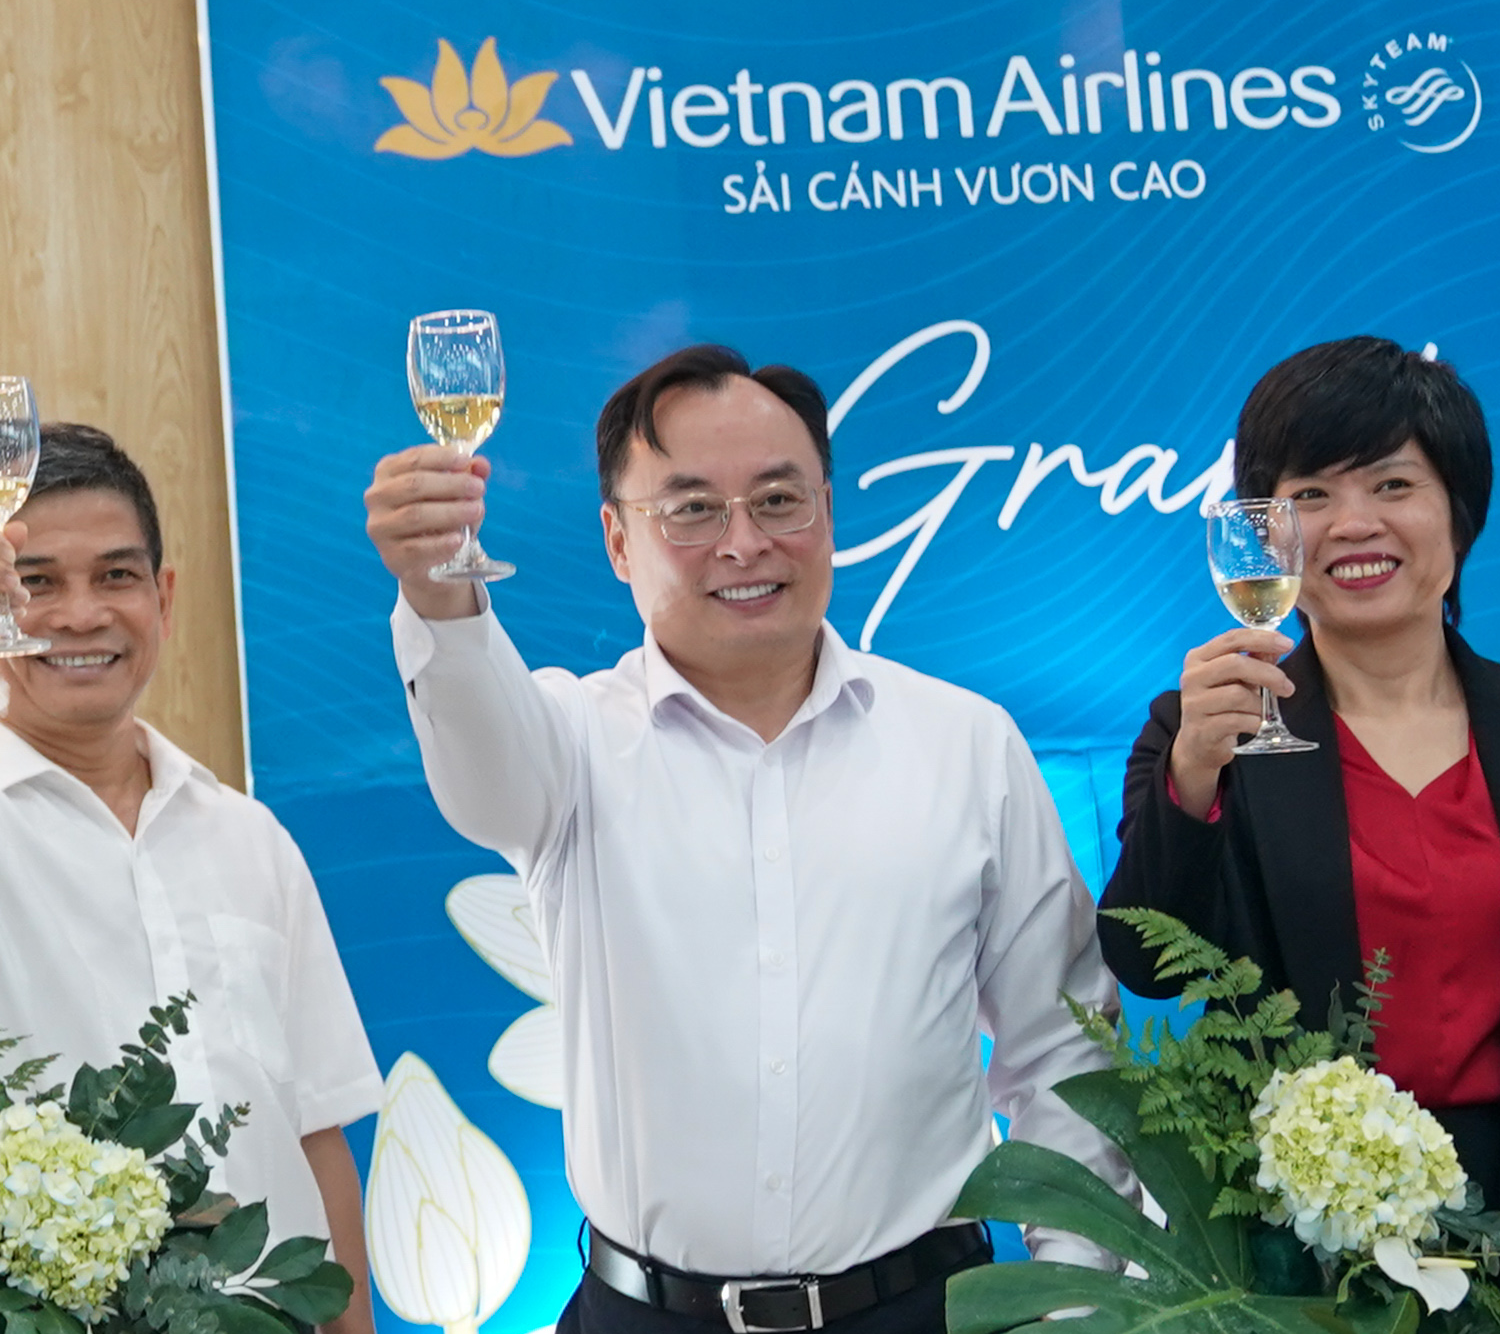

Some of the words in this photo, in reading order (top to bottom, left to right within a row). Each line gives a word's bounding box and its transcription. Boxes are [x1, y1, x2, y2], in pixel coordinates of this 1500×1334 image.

[570, 66, 965, 151] Vietnam
[987, 50, 1342, 139] Airlines
[1362, 32, 1448, 132] SKYTEAM
[723, 160, 792, 215] SẢI
[807, 160, 943, 211] CÁNH
[955, 159, 1096, 207] VƯƠN
[1110, 158, 1208, 203] CAO
[827, 319, 1440, 653] Gra
